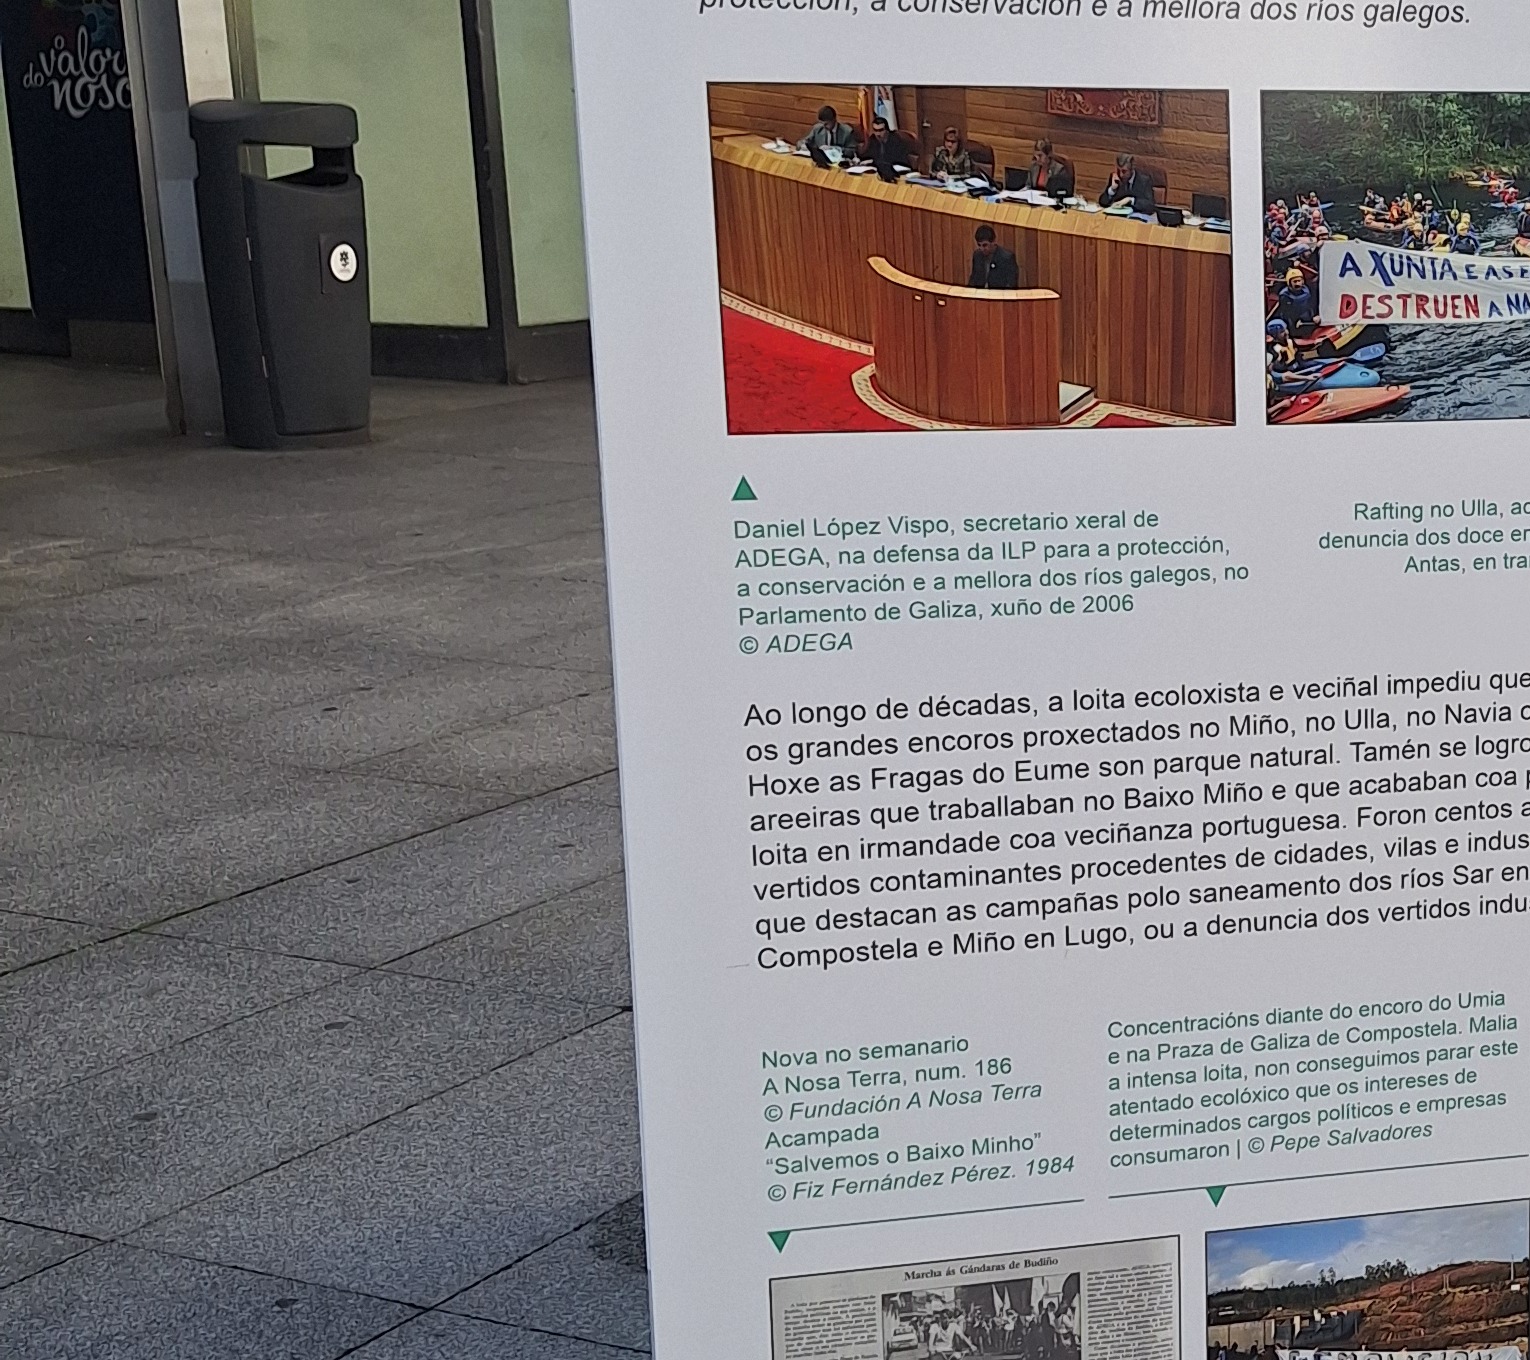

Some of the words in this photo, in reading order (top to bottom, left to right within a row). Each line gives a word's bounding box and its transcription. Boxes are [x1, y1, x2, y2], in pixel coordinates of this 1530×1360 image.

[1339, 251, 1362, 277] A
[1368, 250, 1458, 286] XUNTA
[1464, 263, 1478, 280] E
[1484, 264, 1514, 281] AS
[1339, 293, 1481, 320] DESTRUEN
[1487, 300, 1503, 319] A
[734, 518, 805, 539] Daniel
[813, 517, 882, 541] López
[887, 515, 955, 538] Vispo,
[963, 511, 1069, 533] secretario
[1075, 510, 1126, 530] xeral
[1133, 509, 1159, 528] de
[1354, 501, 1423, 524] Rafting
[1430, 504, 1455, 518] no
[1461, 498, 1504, 519] Ulla,
[743, 703, 782, 727] Ao
[791, 701, 867, 728] longo
[876, 697, 909, 720] de
[918, 692, 1038, 718] décadas,
[1048, 695, 1064, 712] a
[1073, 688, 1125, 711] loita
[1134, 682, 1260, 708] ecoloxista
[1269, 684, 1284, 701] e
[1292, 674, 1378, 700] veciñal
[1387, 670, 1481, 699] impediu
[1107, 1011, 1260, 1039] Concentracións
[1265, 1005, 1324, 1025] diante
[1329, 1002, 1353, 1020] do
[1358, 1000, 1423, 1018] encoro
[1428, 994, 1452, 1012] do
[1458, 990, 1505, 1009] Umia
[761, 1050, 818, 1069] Nova
[825, 1048, 852, 1064] no
[858, 1035, 969, 1061] semanario
[762, 1077, 779, 1097] A
[785, 1075, 841, 1094] Nosa
[846, 1069, 907, 1088] Terra,
[915, 1065, 966, 1083] num.
[975, 1057, 1012, 1077] 186
[904, 1269, 942, 1281] Marcha
[959, 1263, 1005, 1275] Gándaras
[1008, 1260, 1020, 1270] de
[1023, 1256, 1059, 1269] Budiño
